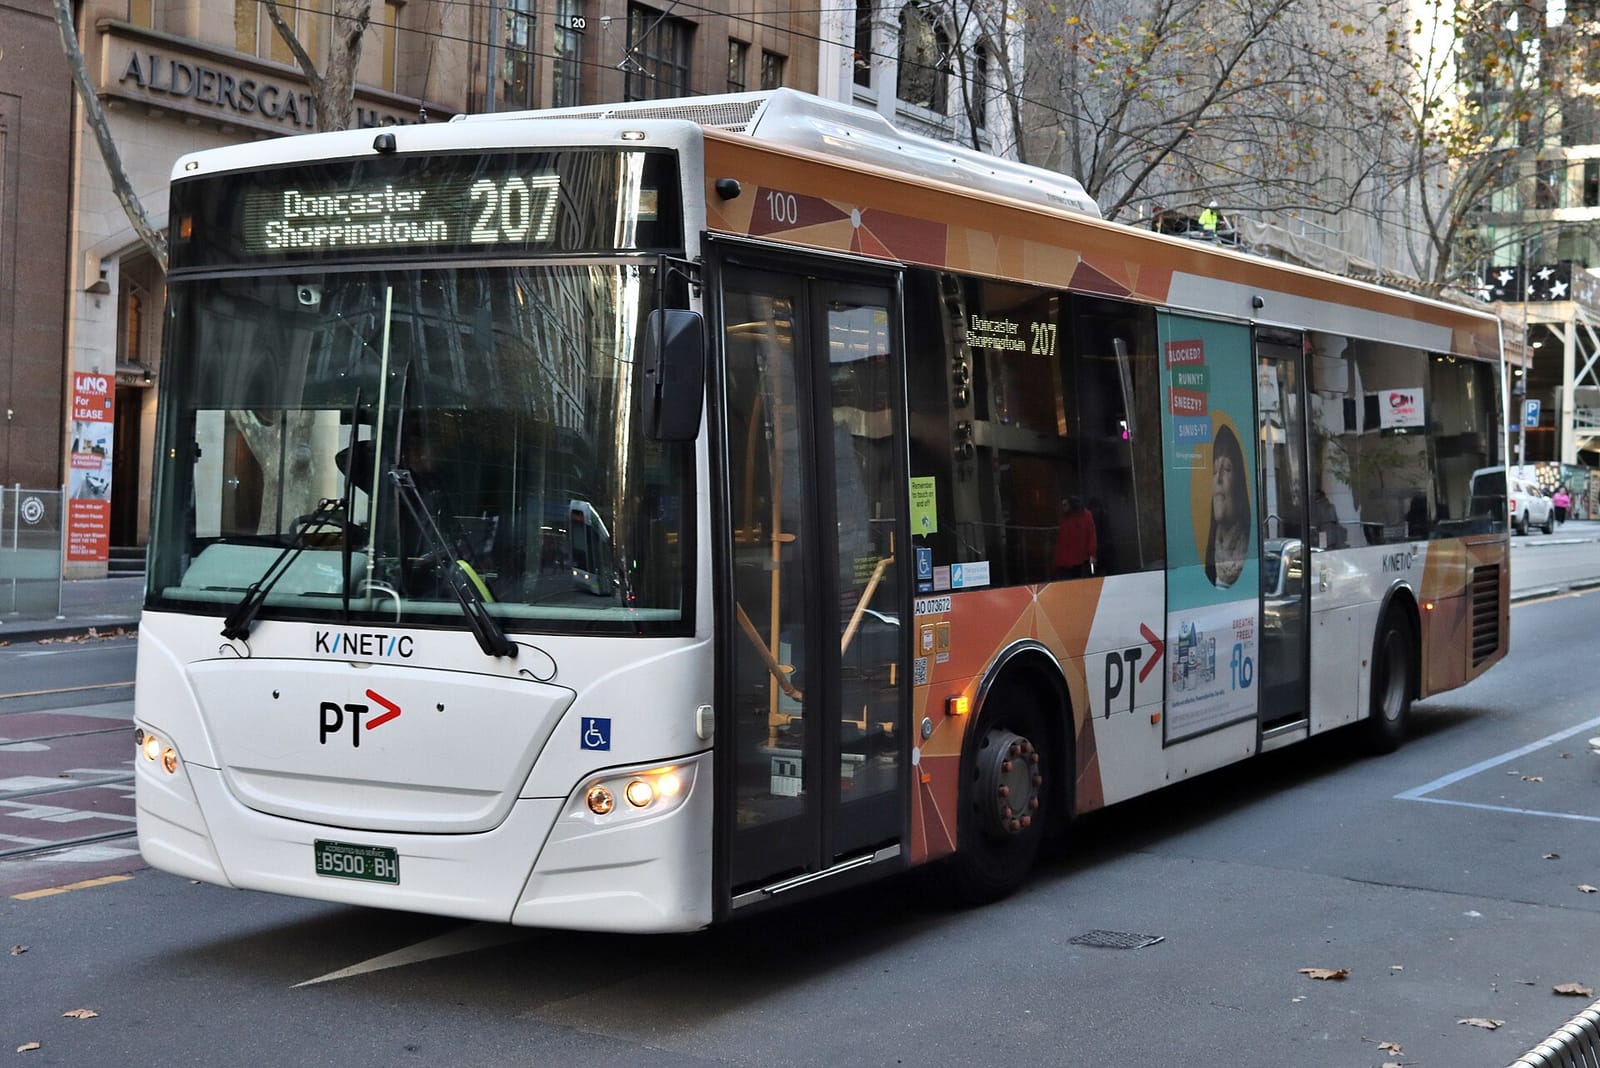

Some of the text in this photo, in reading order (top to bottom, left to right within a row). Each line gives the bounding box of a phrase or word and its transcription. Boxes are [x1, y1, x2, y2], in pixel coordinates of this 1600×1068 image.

[573, 17, 586, 29] 20
[119, 51, 316, 128] ALDERSGAT
[284, 185, 426, 218] Doncaster
[470, 175, 561, 243] 207
[767, 190, 798, 225] 100
[1030, 321, 1057, 356] 207
[1168, 346, 1201, 362] BLOCKED?
[75, 376, 108, 393] LINQ
[75, 396, 90, 406] For
[1174, 395, 1202, 411] SNEEZY?
[1528, 402, 1538, 414] P
[75, 408, 104, 420] LEASE
[926, 598, 951, 613] 073672
[374, 857, 397, 879] BH
